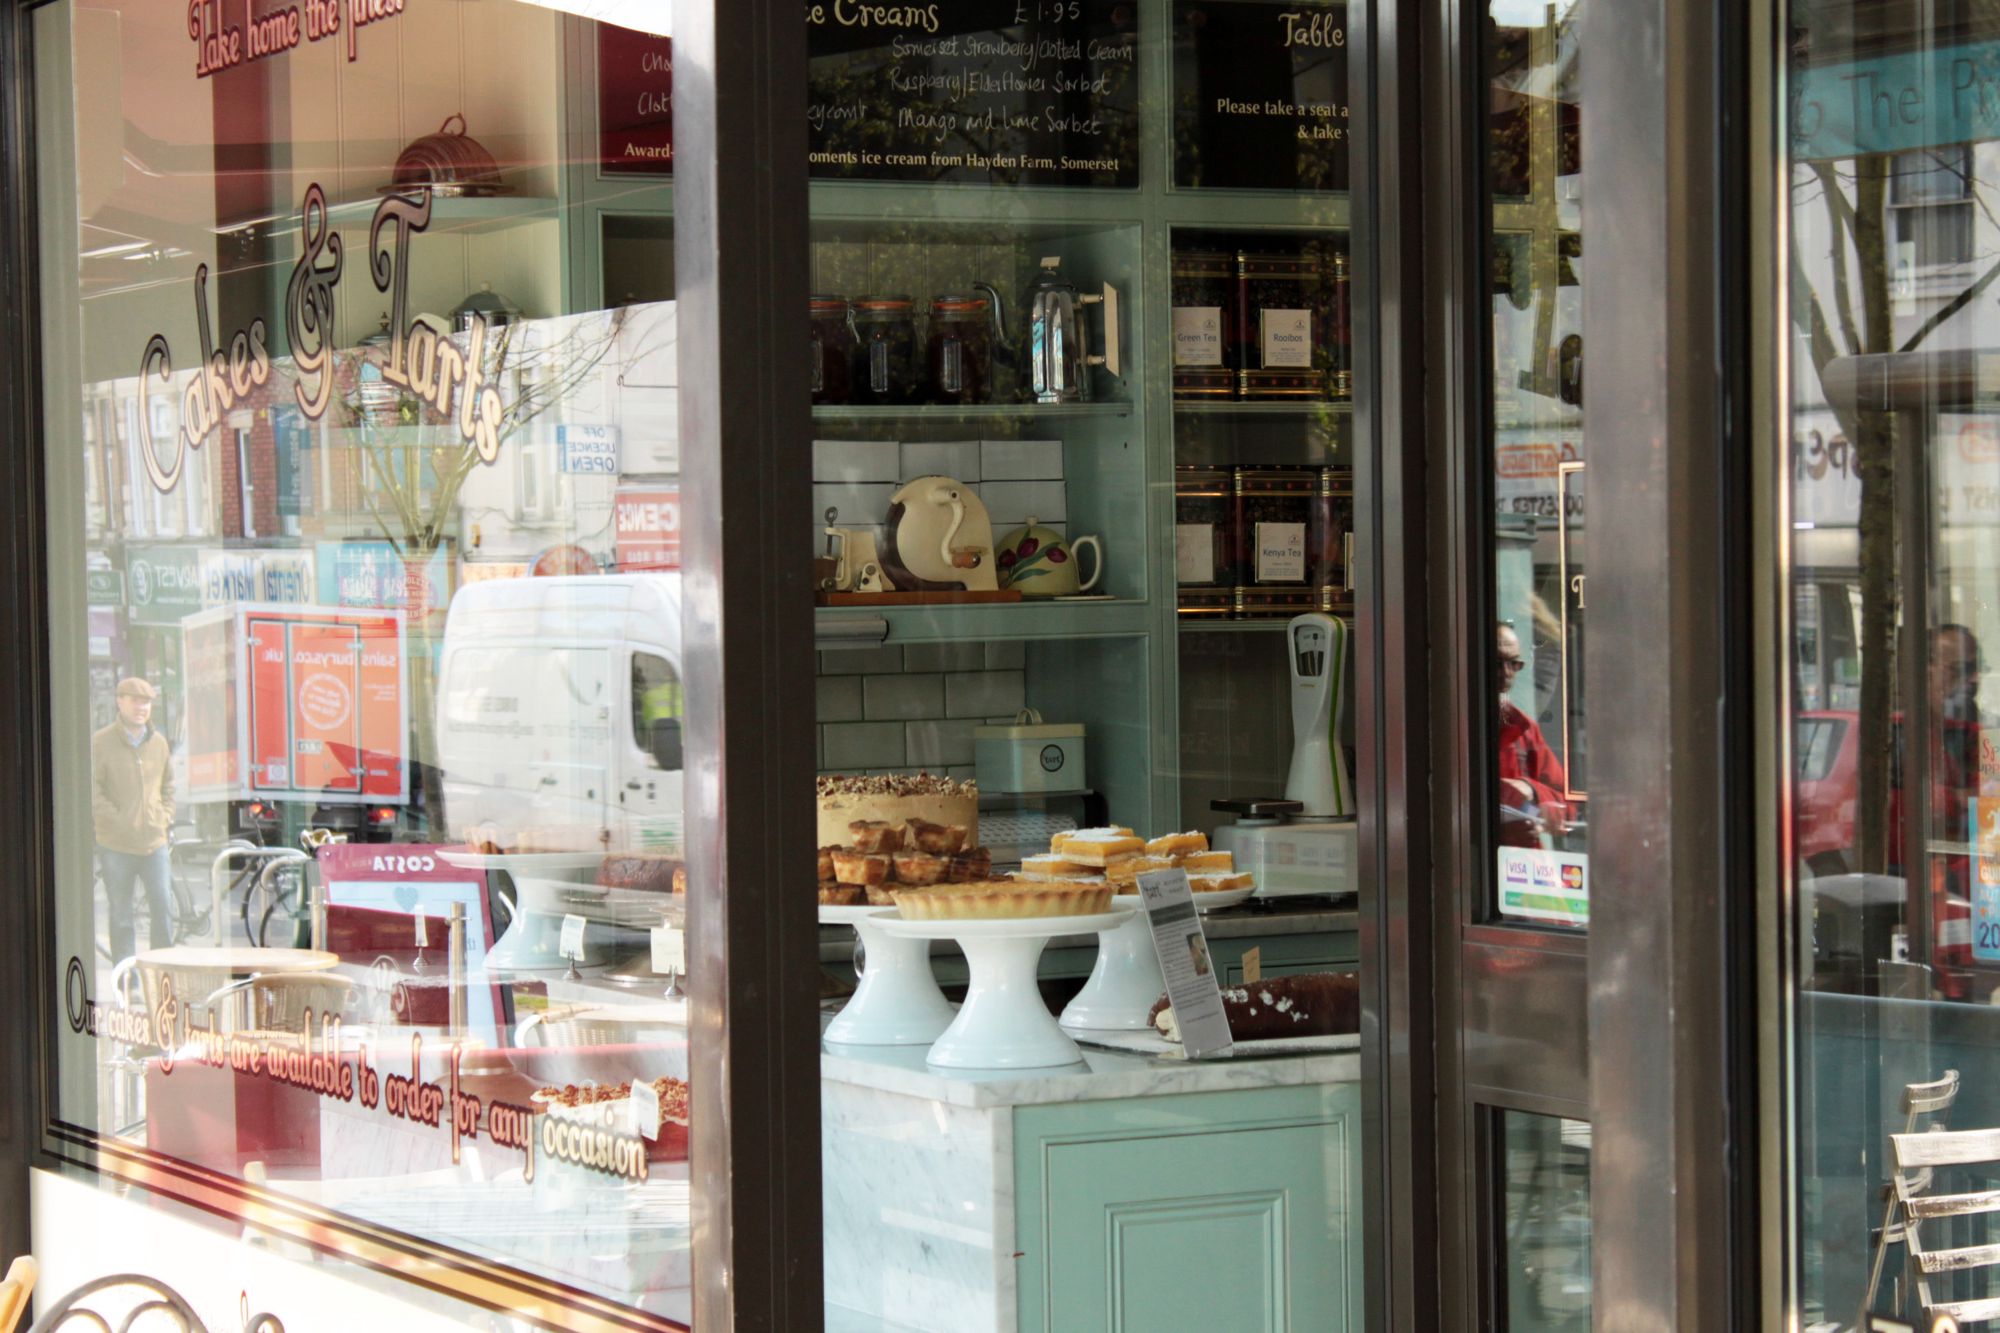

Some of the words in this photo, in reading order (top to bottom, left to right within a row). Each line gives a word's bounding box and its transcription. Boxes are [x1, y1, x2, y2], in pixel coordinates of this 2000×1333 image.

[834, 0, 939, 33] Creams
[246, 0, 300, 61] home
[305, 0, 339, 42] the
[1278, 13, 1345, 48] Table
[892, 35, 959, 58] Somerset
[1087, 38, 1133, 62] Cream
[1217, 97, 1261, 115] Please
[1265, 99, 1294, 116] take
[1297, 105, 1306, 117] a
[1310, 103, 1337, 118] seat
[898, 107, 957, 142] Mango
[1297, 125, 1309, 139] &
[1313, 124, 1342, 140] take
[861, 149, 881, 165] ice
[885, 153, 927, 166] cream
[931, 152, 963, 167] from
[966, 153, 1017, 171] Hayden
[1020, 154, 1057, 171] Farm,
[1061, 155, 1120, 172] Somerset
[139, 262, 269, 492] Cakes
[286, 182, 342, 421] &
[370, 186, 502, 466] Tarts
[1177, 332, 1200, 343] Green
[1203, 332, 1217, 343] Tea
[1273, 332, 1303, 343] Rooibos
[1262, 548, 1287, 558] Kenya
[1288, 548, 1302, 558] Tea
[1508, 861, 1528, 875] VISA
[1535, 863, 1555, 878] VISA
[66, 956, 102, 1035] Our
[108, 971, 149, 1046] cakes
[156, 972, 179, 1075] &
[184, 1001, 225, 1070] tarts
[230, 1036, 262, 1075] are
[266, 1005, 354, 1104] available
[359, 1042, 380, 1110] to
[385, 1031, 444, 1129] order
[450, 1039, 481, 1165] for
[489, 1099, 535, 1183] any
[542, 1102, 649, 1182] occasion
